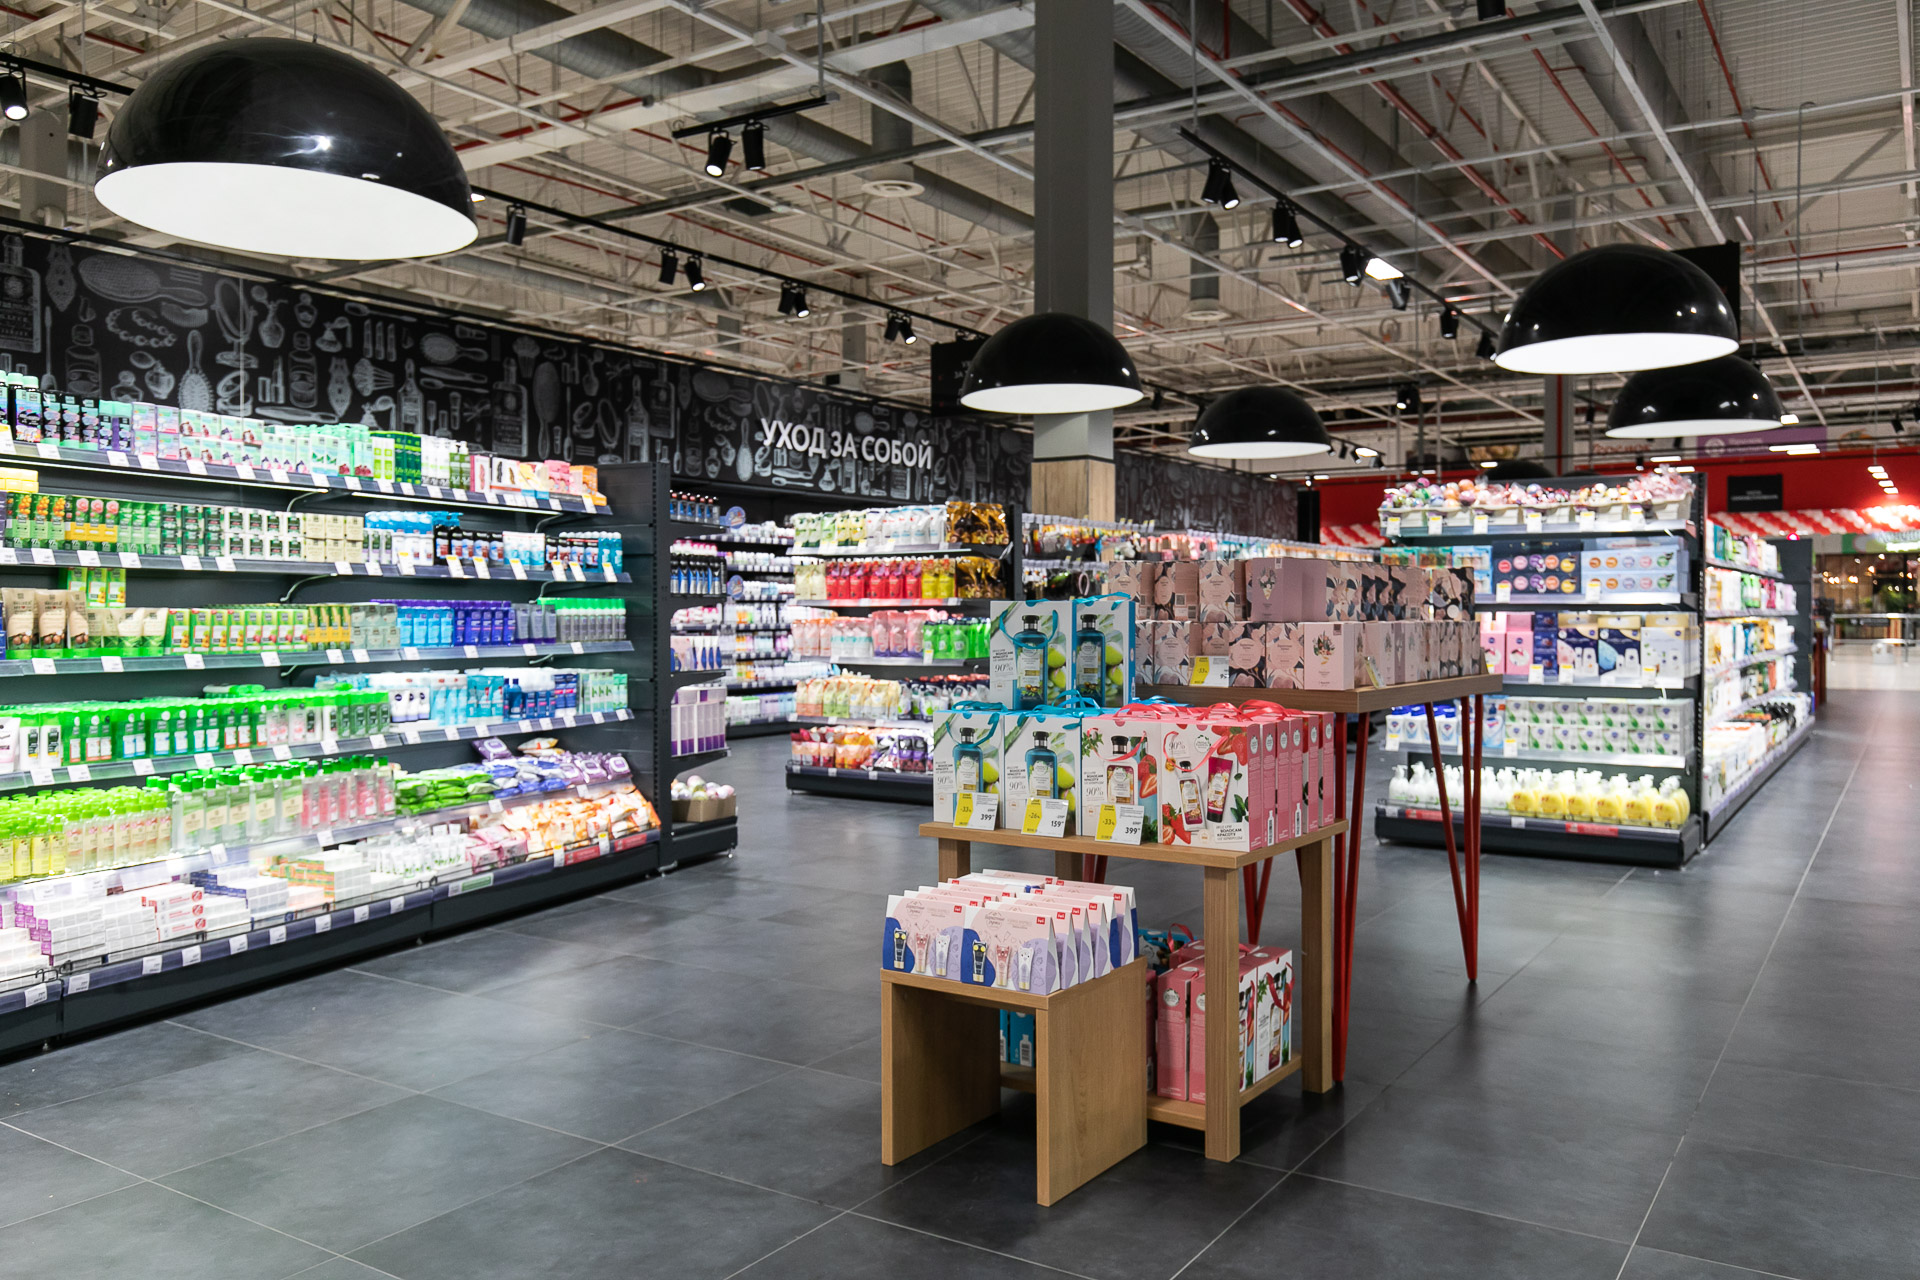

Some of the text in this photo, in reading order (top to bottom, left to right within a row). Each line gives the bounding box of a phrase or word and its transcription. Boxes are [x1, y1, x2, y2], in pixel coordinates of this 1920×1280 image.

[760, 417, 932, 470] УХОД ЗА СОБОЙ
[1051, 820, 1062, 828] 159
[1125, 827, 1138, 835] 399
